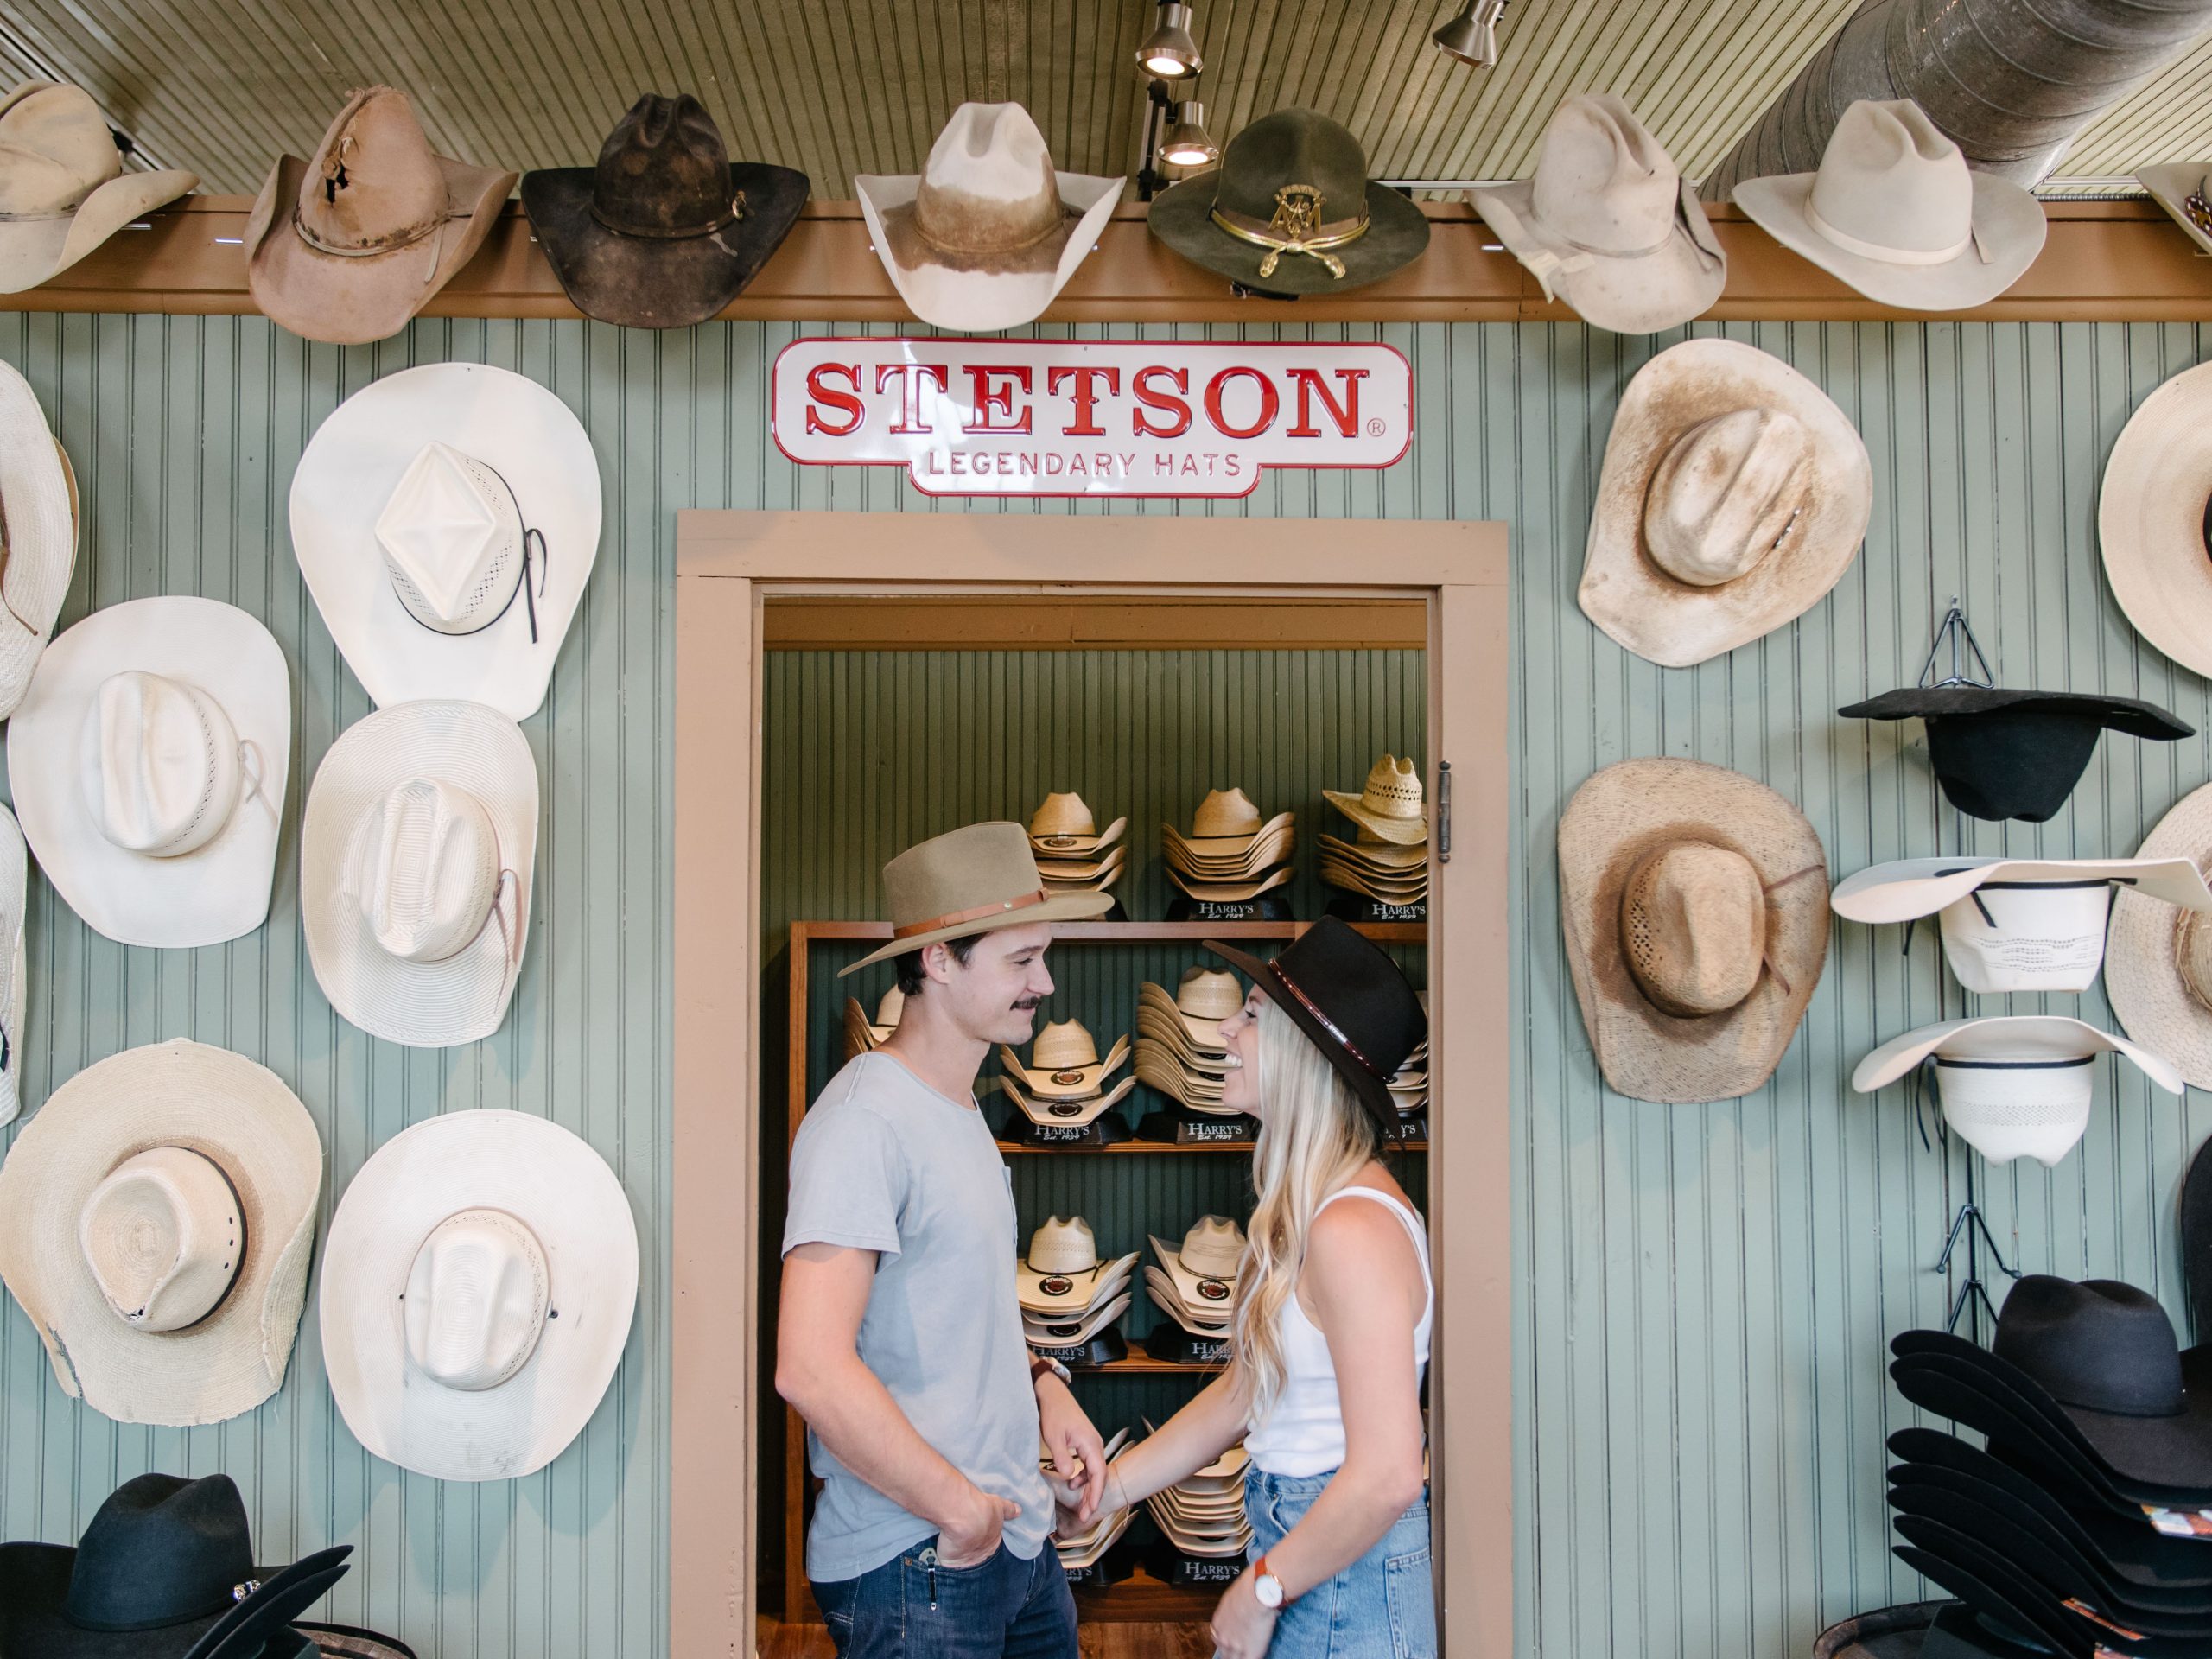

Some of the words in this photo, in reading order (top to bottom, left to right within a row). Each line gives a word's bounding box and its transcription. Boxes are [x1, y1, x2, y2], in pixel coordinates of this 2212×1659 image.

[929, 452, 1135, 476] LEGENDARY
[1154, 454, 1242, 477] HATS
[1199, 902, 1254, 914] HARRY'S
[1372, 903, 1427, 915] HARRY'S
[1034, 1125, 1090, 1135] HARRY'S
[1188, 1122, 1243, 1135] HARRY'S
[1184, 1561, 1240, 1575] HARRY'S
